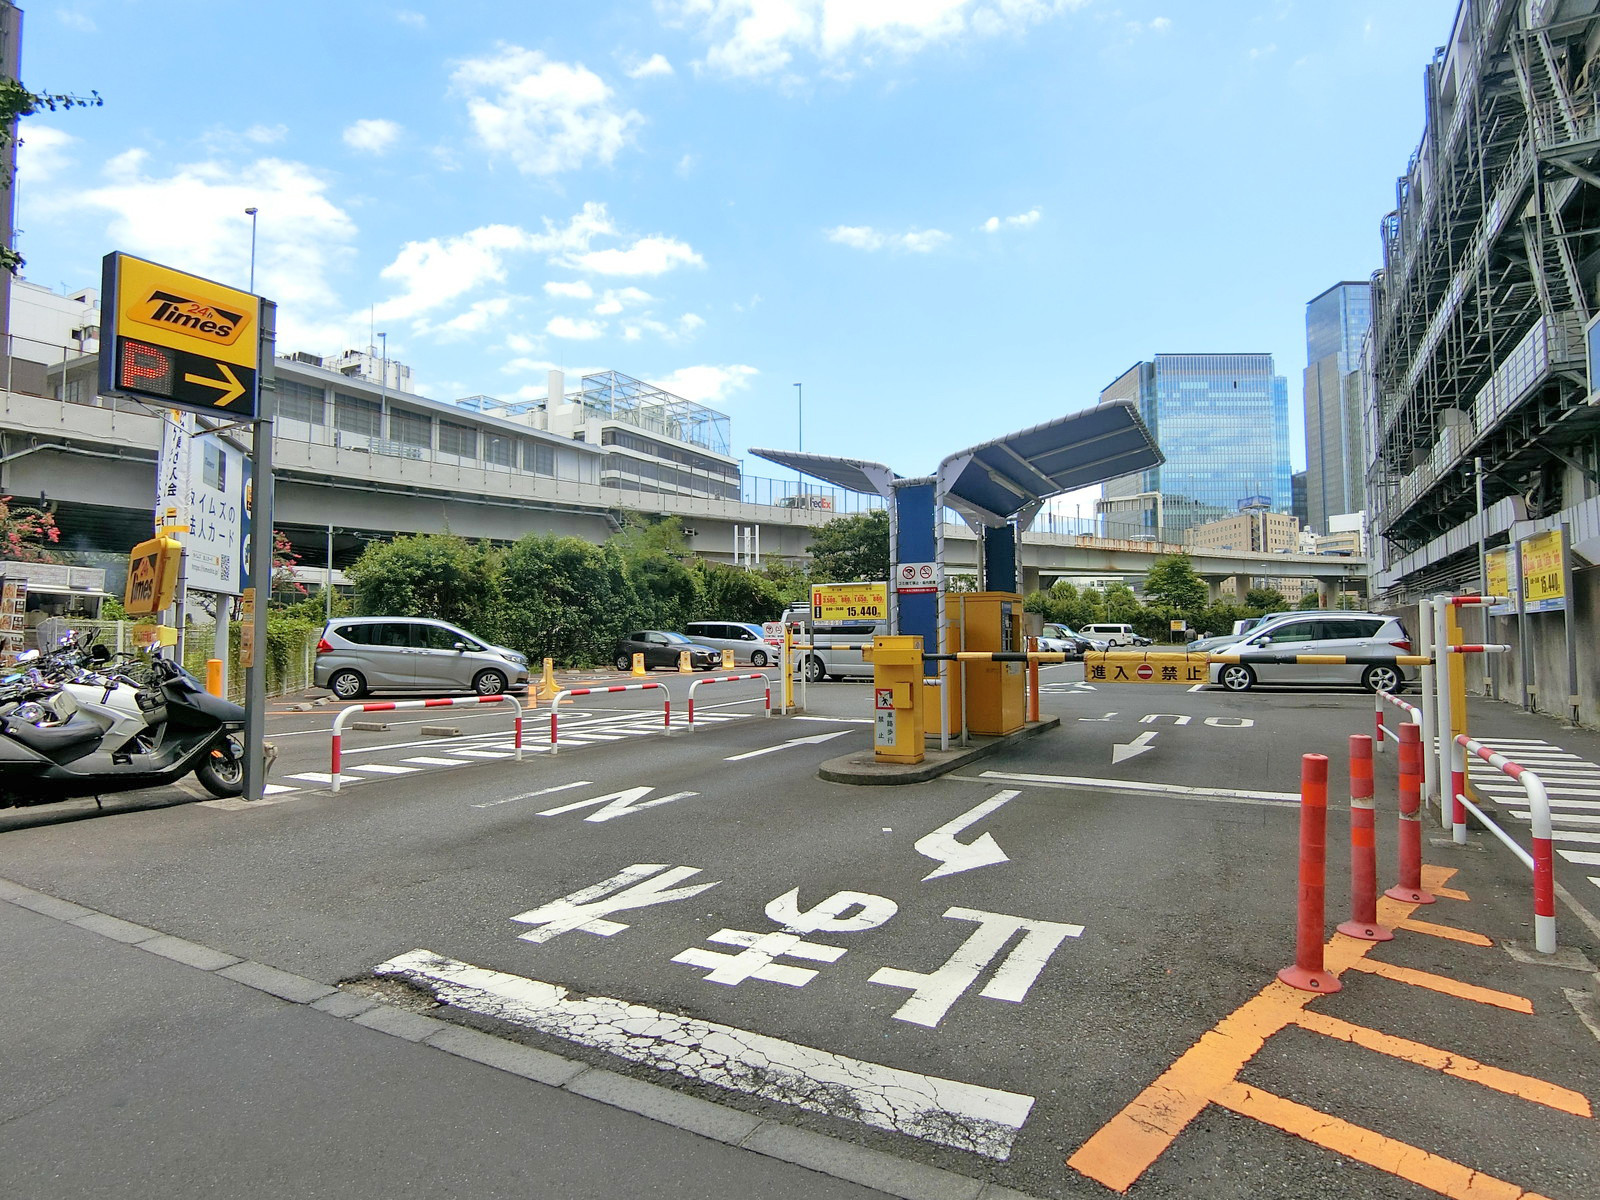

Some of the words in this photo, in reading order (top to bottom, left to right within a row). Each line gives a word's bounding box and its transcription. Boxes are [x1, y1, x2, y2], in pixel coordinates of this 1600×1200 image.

[147, 295, 234, 338] Times
[187, 303, 213, 319] 24h
[122, 341, 170, 388] P
[810, 497, 832, 509] FedEx
[1091, 665, 1130, 681] 進入
[1161, 666, 1203, 681] 禁止
[510, 863, 1085, 1029] 止まれ
